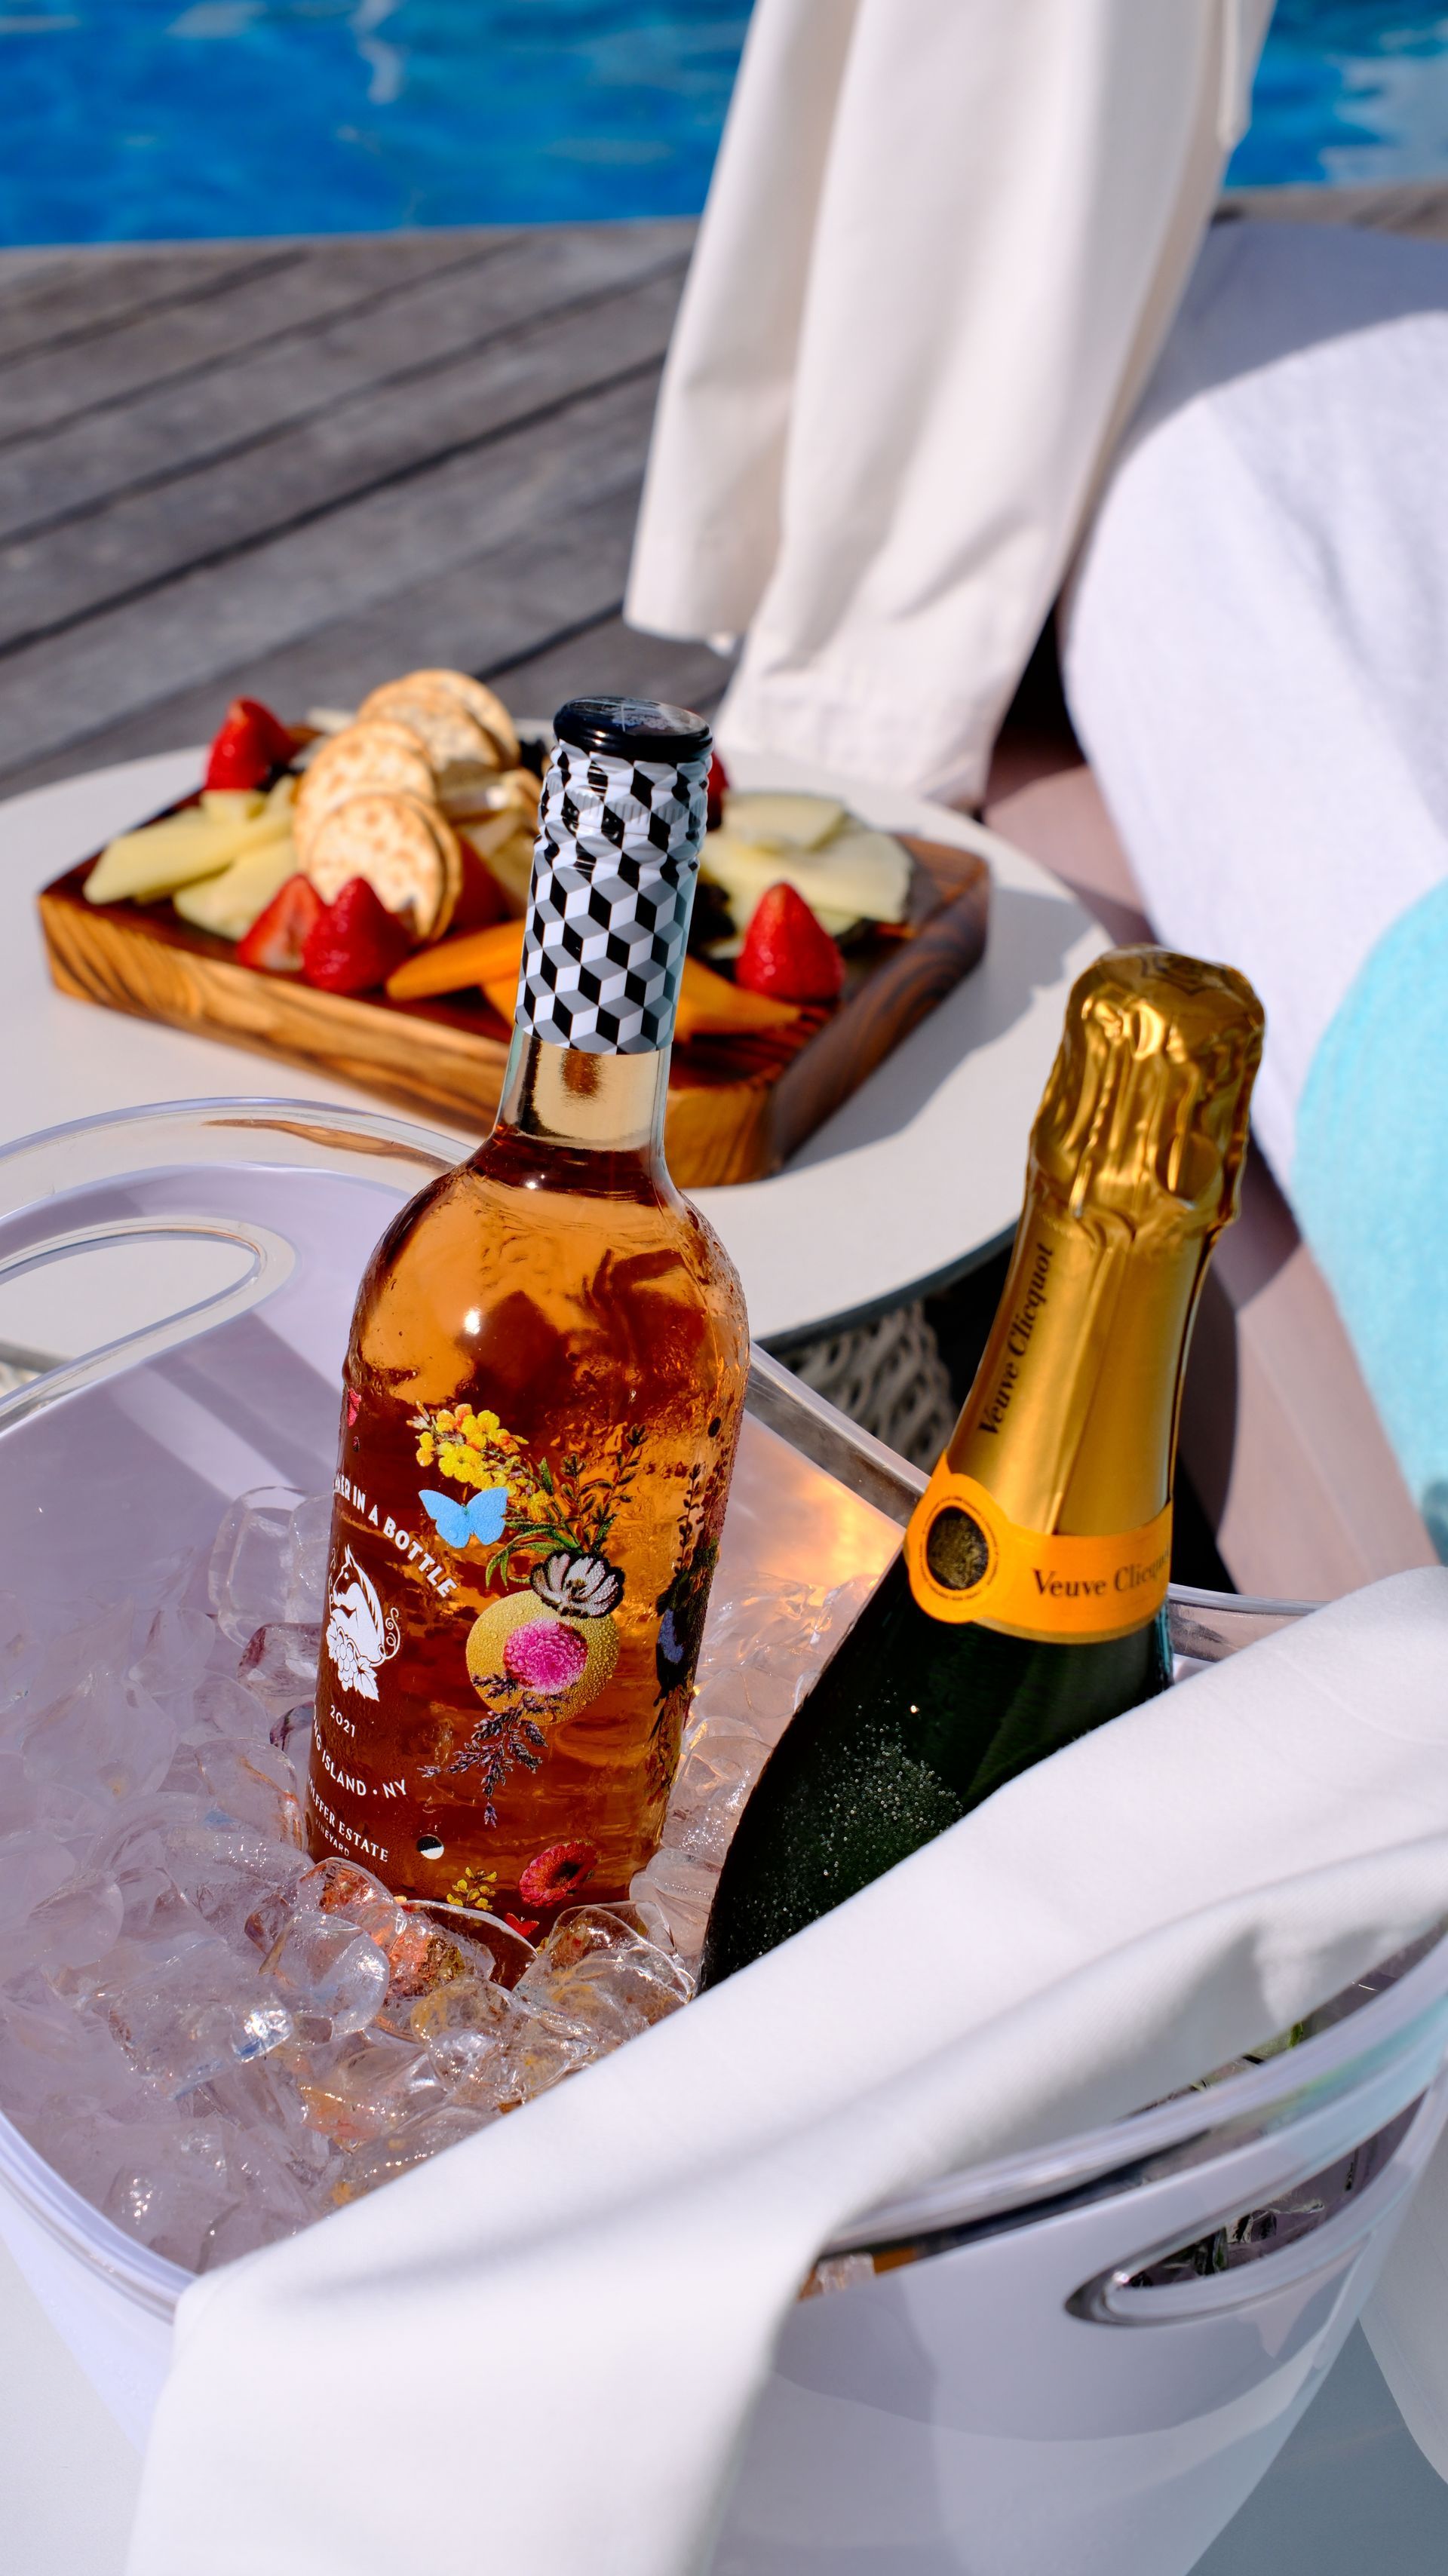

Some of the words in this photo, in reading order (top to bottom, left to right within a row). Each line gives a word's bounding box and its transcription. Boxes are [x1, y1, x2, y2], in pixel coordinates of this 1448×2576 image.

[977, 1363, 1019, 1435] Veuve
[1007, 1242, 1054, 1357] Clicquot
[352, 1485, 367, 1514] IN
[368, 1504, 379, 1526] A
[383, 1516, 458, 1598] BOTTLE
[1032, 1569, 1107, 1598] Veuve
[330, 1704, 356, 1737] 2021
[321, 1750, 367, 1796] ISLAND
[382, 1779, 407, 1799] NY
[315, 1817, 350, 1857] VINEYARD
[338, 1821, 389, 1863] ESTATE
